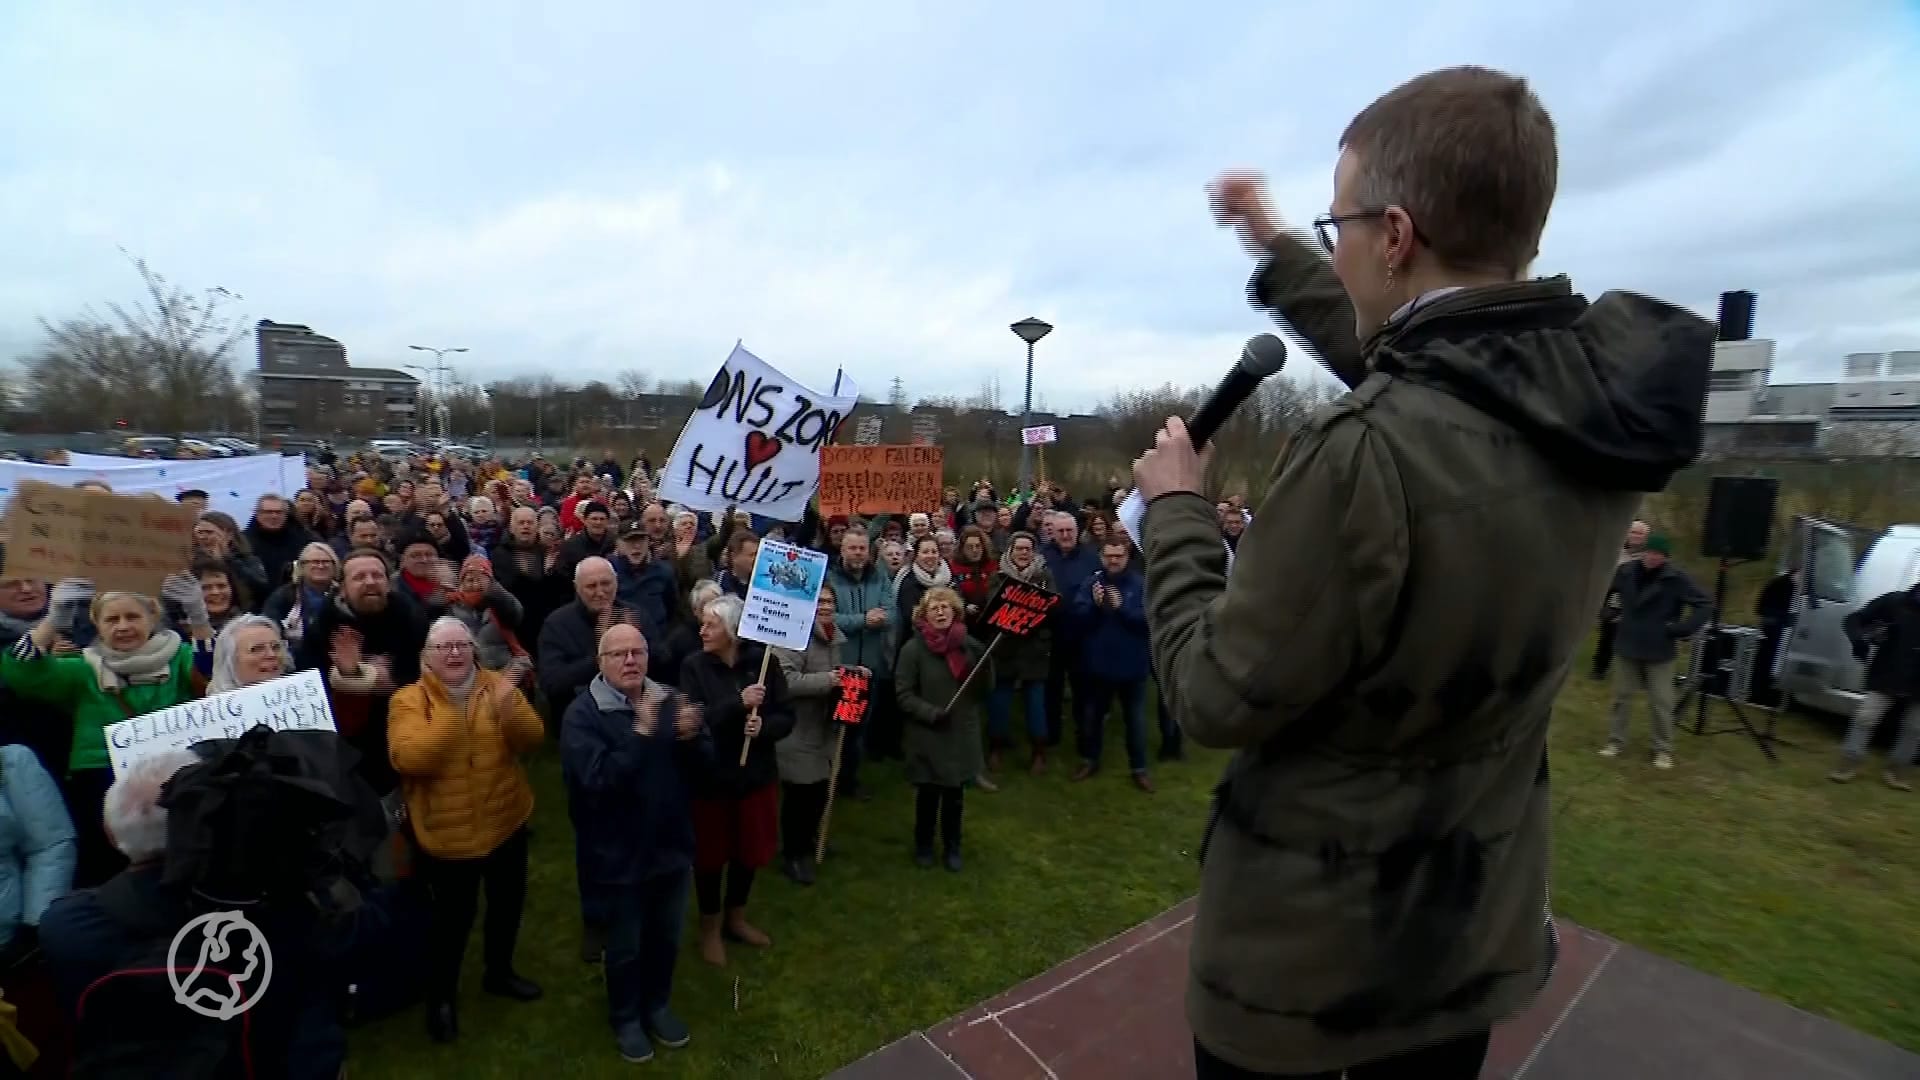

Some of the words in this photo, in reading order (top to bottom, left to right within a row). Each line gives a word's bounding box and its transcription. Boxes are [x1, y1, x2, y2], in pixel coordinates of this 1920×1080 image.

[774, 395, 840, 453] ZOR
[822, 448, 873, 465] DOOR
[885, 447, 942, 464] FALEND
[823, 469, 884, 489] BELEID
[757, 623, 787, 637] Mensen
[111, 697, 243, 749] GELUKKIG
[263, 680, 318, 708] WAS
